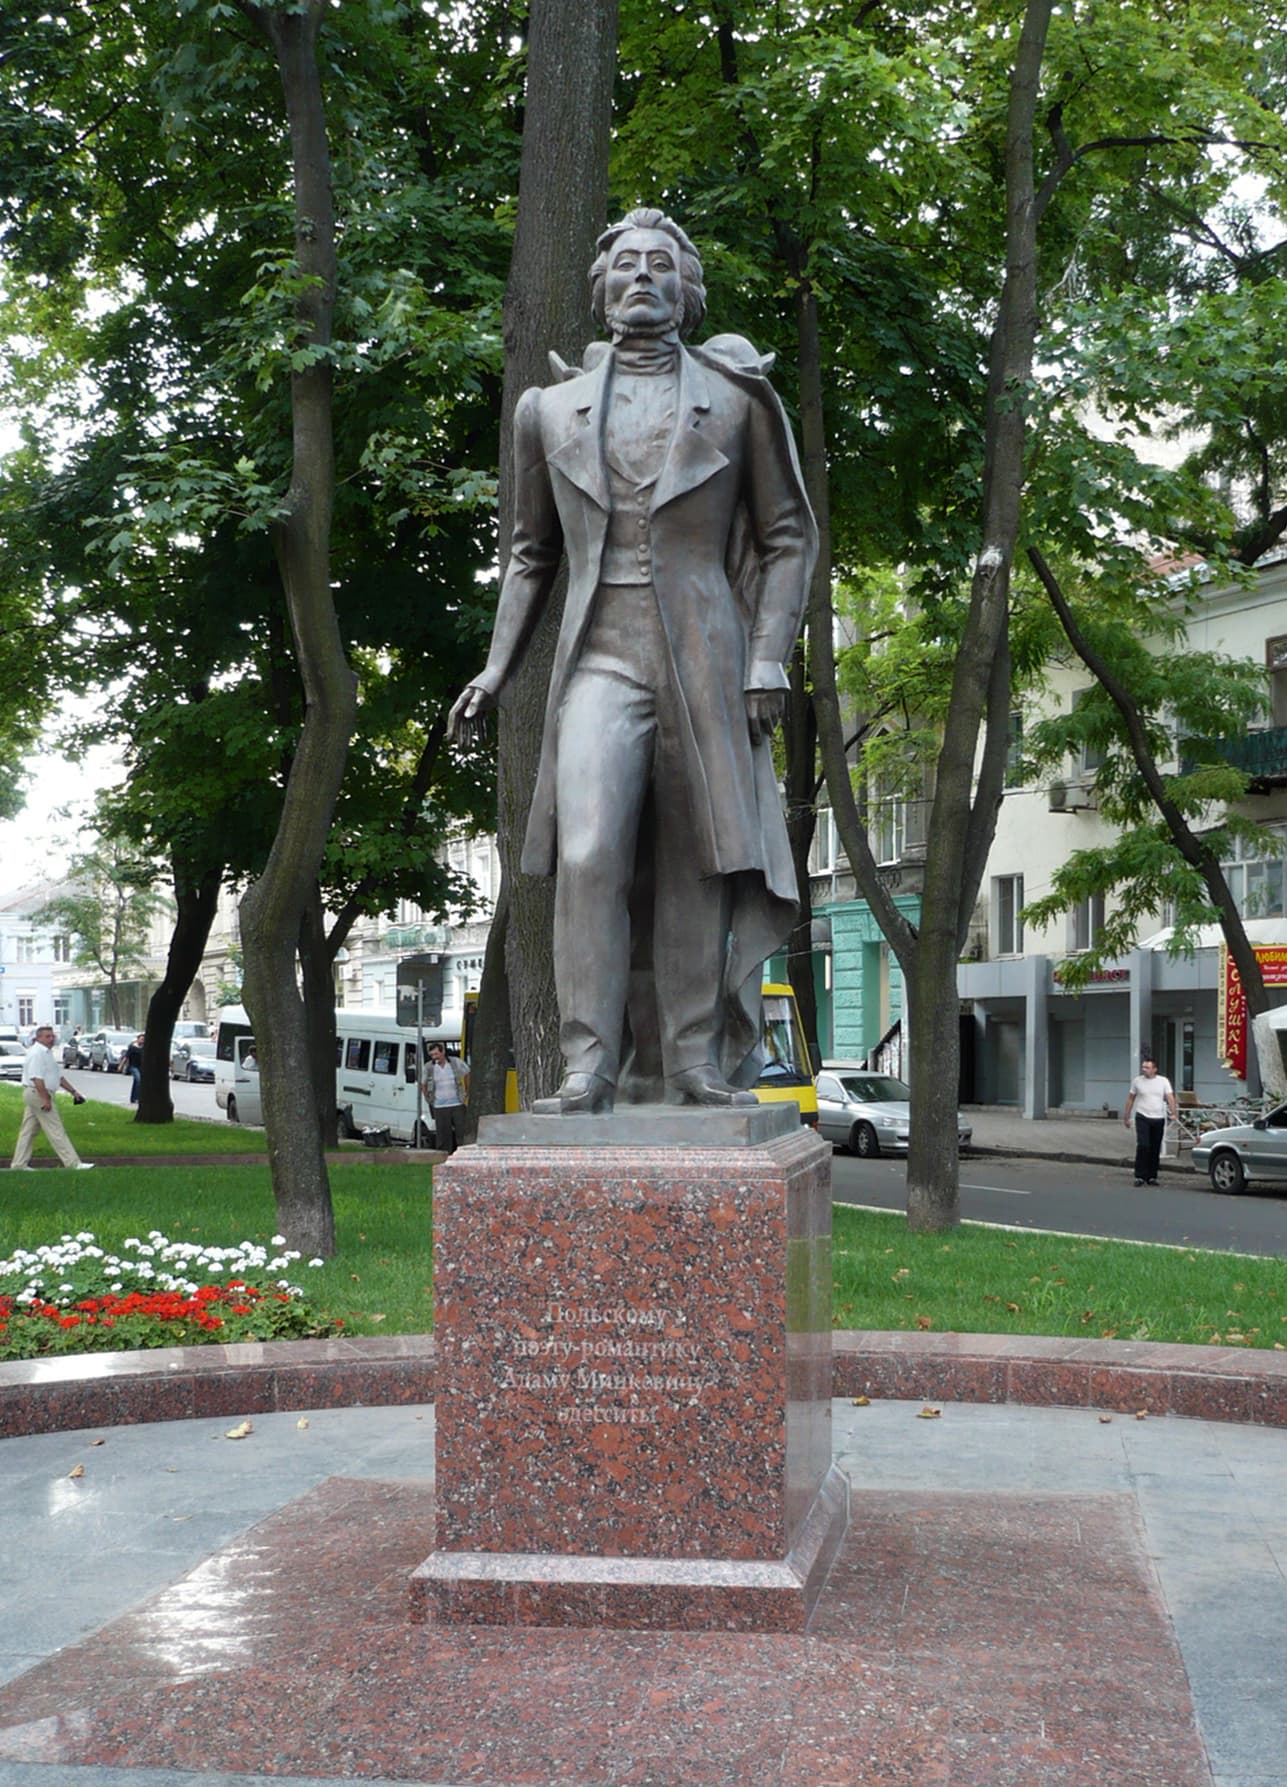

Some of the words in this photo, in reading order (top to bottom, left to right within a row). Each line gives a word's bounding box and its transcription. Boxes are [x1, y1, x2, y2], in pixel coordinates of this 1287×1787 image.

[548, 1302, 667, 1330] Польскому
[514, 1340, 700, 1362] поэту-романтику
[503, 1367, 571, 1394] Адаму
